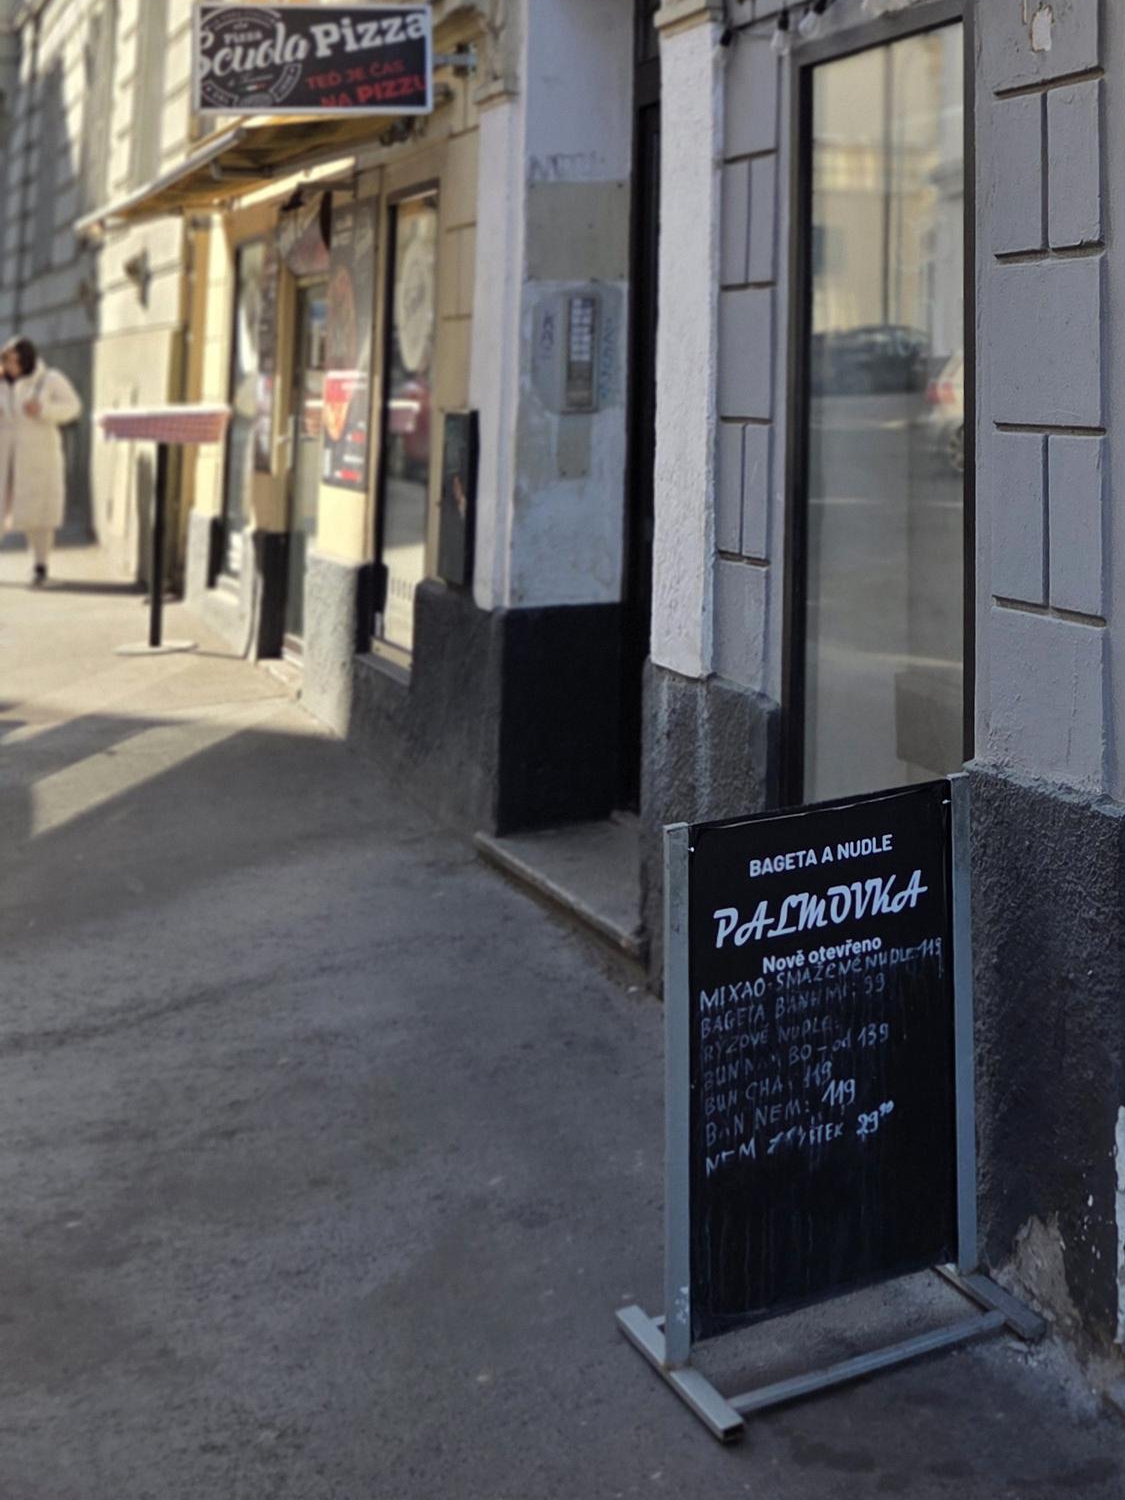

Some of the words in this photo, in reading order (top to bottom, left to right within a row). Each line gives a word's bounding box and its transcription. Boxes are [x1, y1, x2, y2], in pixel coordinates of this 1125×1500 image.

[309, 13, 426, 58] Pizza
[749, 848, 818, 877] BAGETA
[821, 846, 833, 864] A
[837, 834, 893, 860] NUDLE
[713, 869, 928, 948] PALMOVKA
[762, 952, 804, 974] Nově
[808, 936, 882, 964] otevřeno
